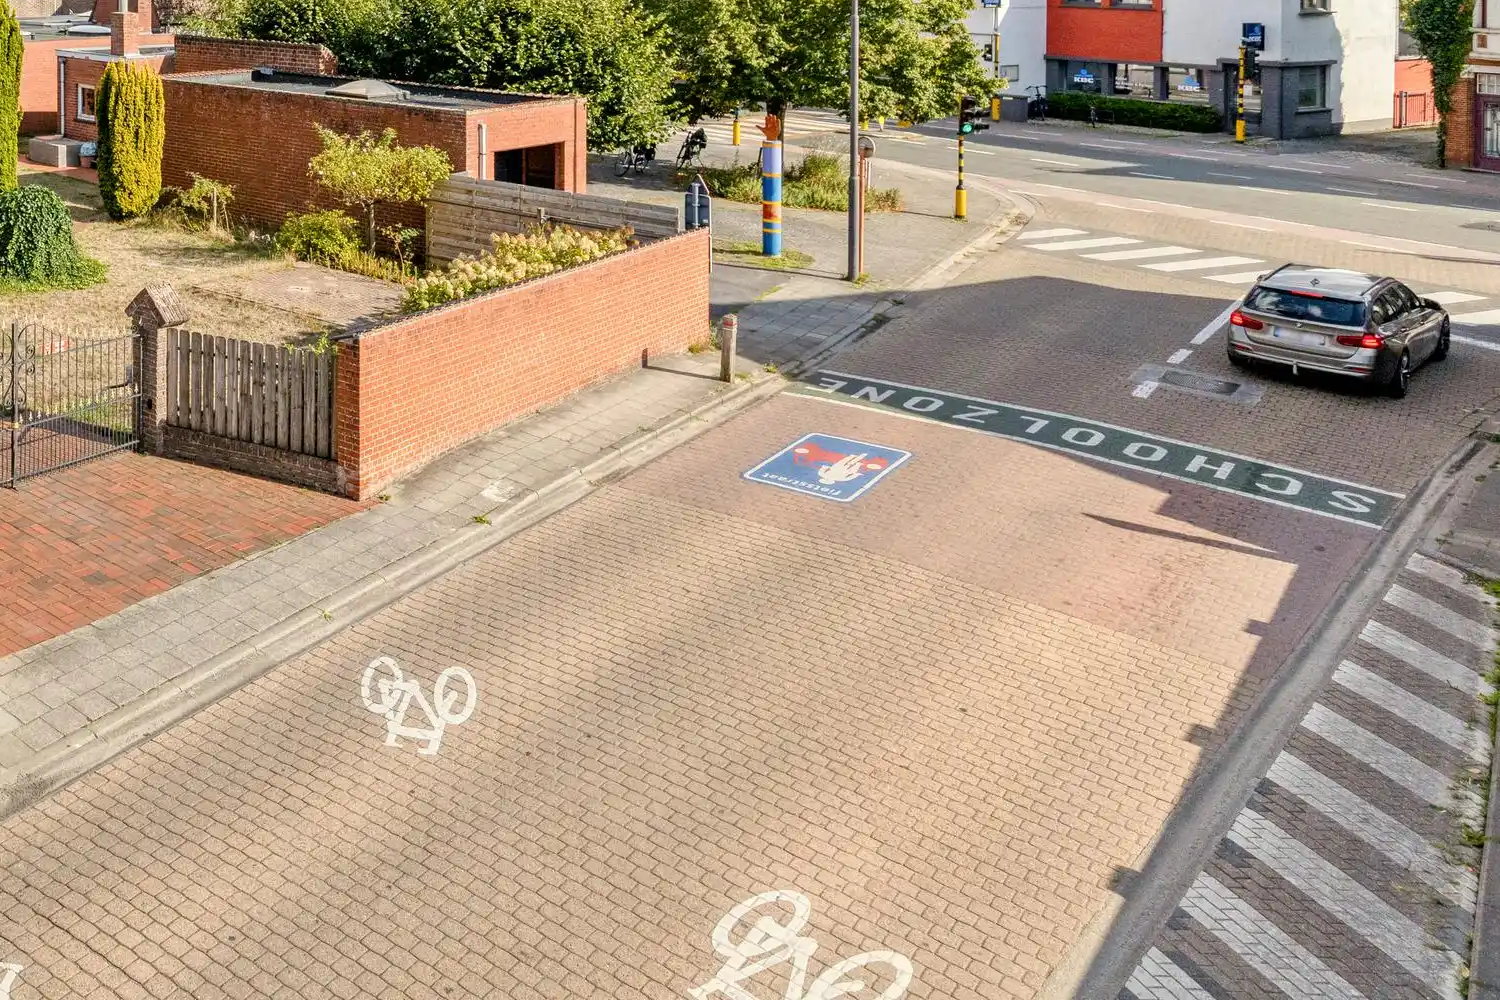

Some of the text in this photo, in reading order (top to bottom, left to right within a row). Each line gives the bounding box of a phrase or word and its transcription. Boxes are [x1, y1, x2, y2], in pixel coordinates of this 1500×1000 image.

[1073, 76, 1095, 84] KBC
[1177, 84, 1201, 92] KBC
[804, 376, 1377, 514] SCHOOLZONE
[761, 472, 842, 497] fietsstraat
